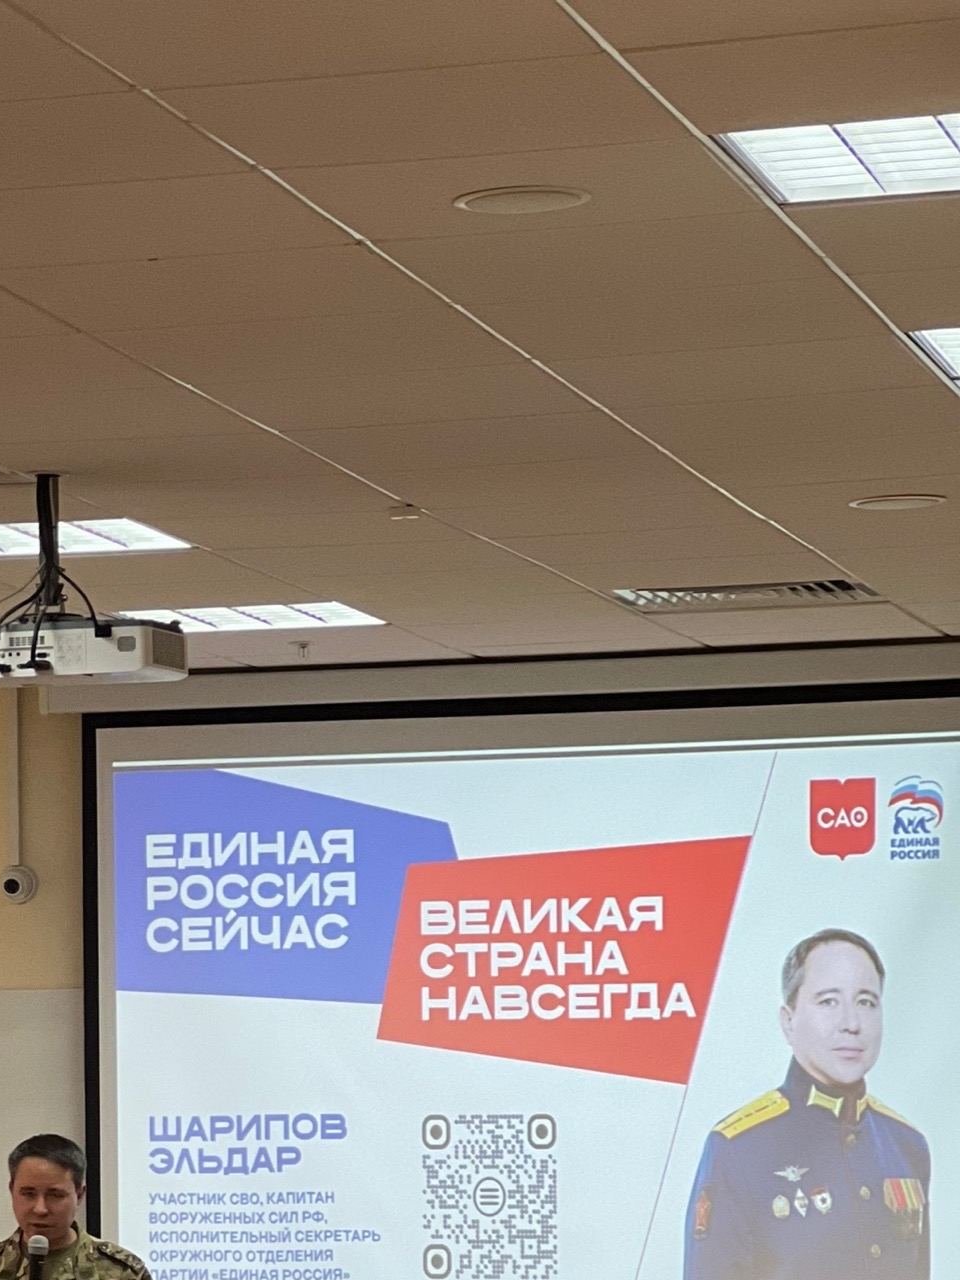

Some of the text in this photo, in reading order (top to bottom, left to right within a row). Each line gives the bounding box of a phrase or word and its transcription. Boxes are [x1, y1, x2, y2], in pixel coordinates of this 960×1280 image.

[817, 806, 868, 829] САО
[146, 829, 355, 869] ЕДИНАЯ
[890, 837, 940, 848] ЕДИНАЯ
[890, 849, 940, 860] РОССИЯ
[146, 871, 357, 911] РОССИЯ
[420, 896, 664, 935] ВЕЛИКАЯ
[146, 909, 349, 952] СЕЙЧАС
[420, 940, 629, 978] СТРАНА
[421, 982, 697, 1021] НАВСЕГДА
[149, 1113, 348, 1142] ШАРИПОВ
[149, 1146, 302, 1175] ЭЛЬДАР
[149, 1191, 335, 1207] УЧАСТНИК СВО, КАПИТАН
[149, 1210, 328, 1225] ВООРУЖЕННЫХ СИЛ РФ,
[149, 1227, 381, 1243] ИСПОЛНИТЕЛЬНЫЙ СЕКРЕТАРЬ
[149, 1249, 334, 1264] ОКРУЖНОГО ОТДЕЛЕНИЯ
[282, 1268, 350, 1280] РОССИЯ»
